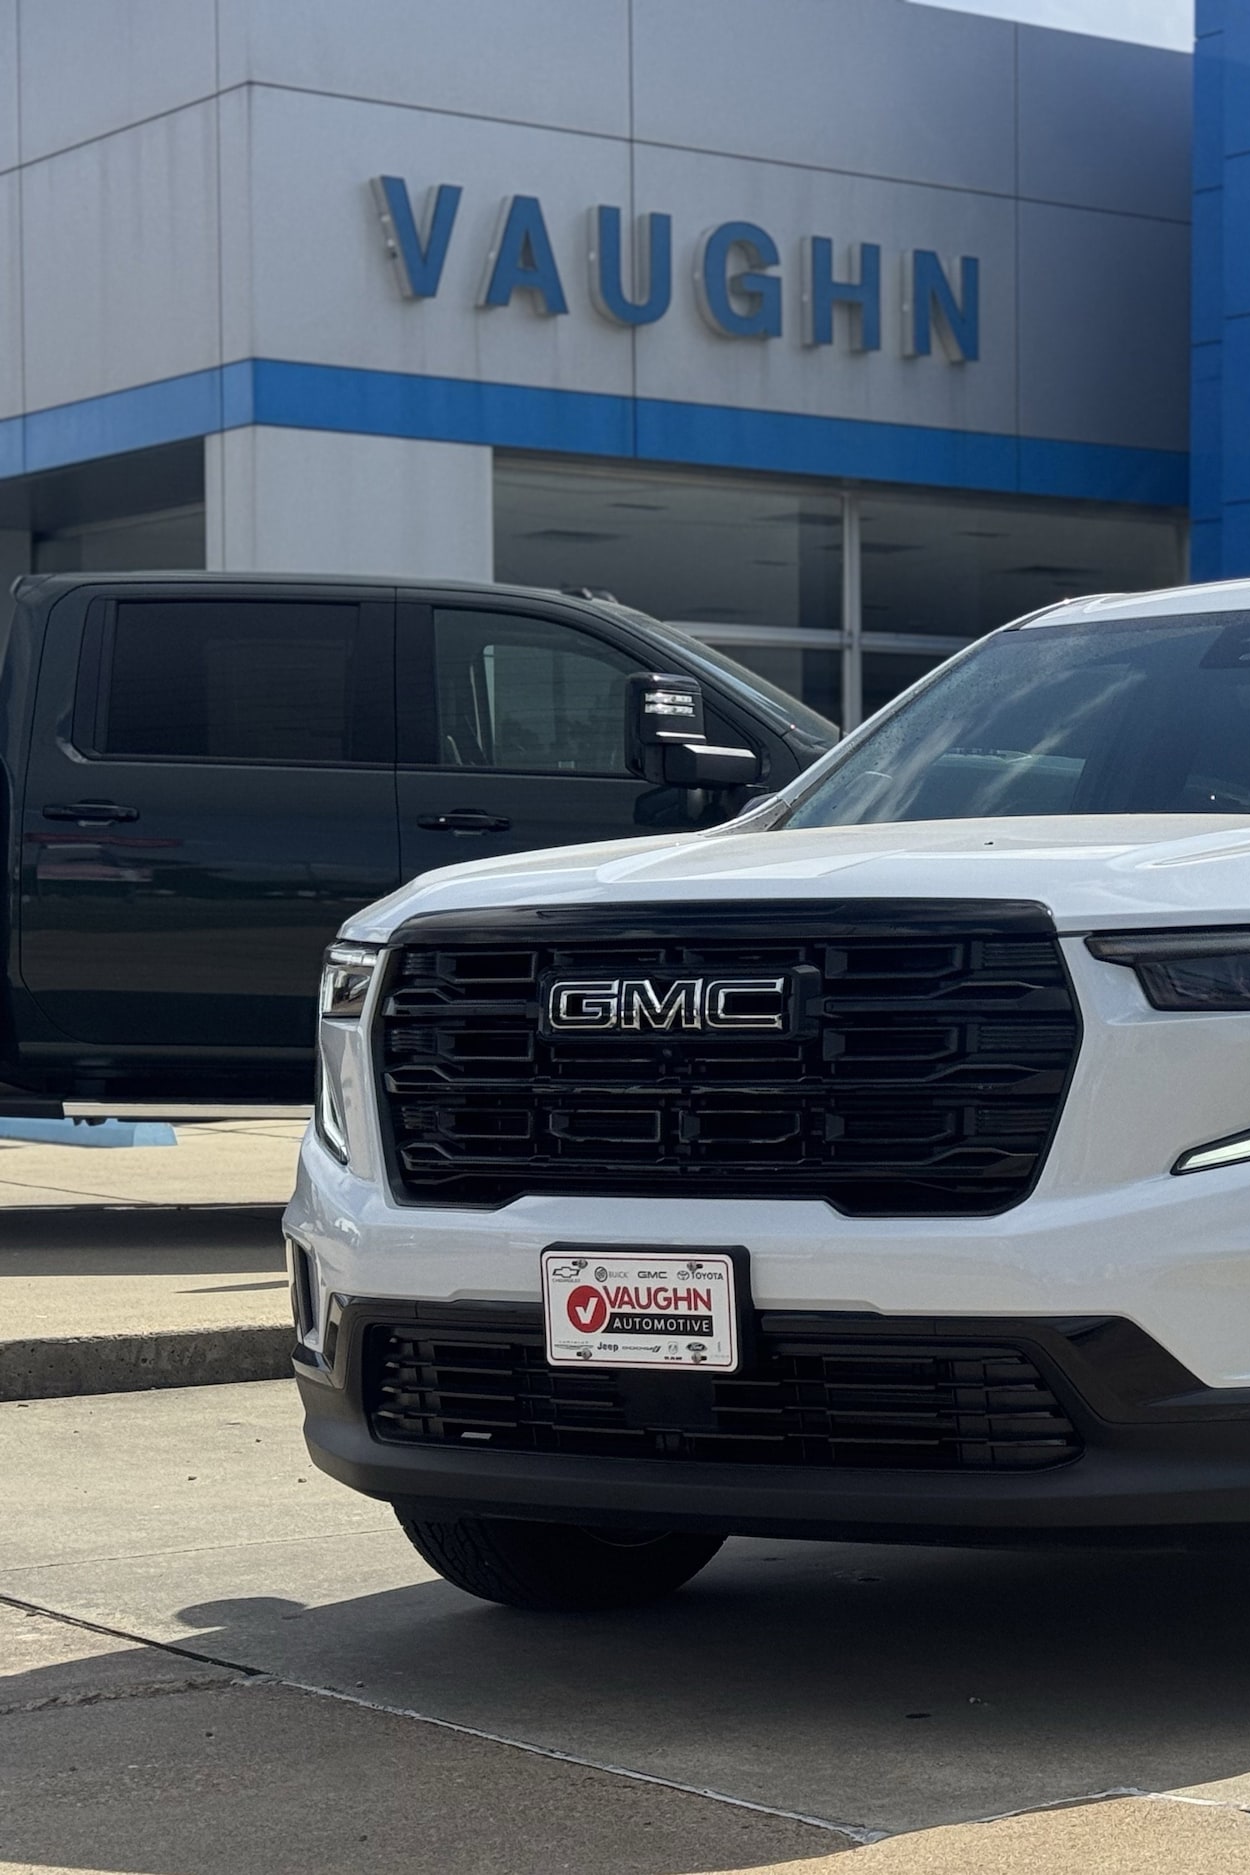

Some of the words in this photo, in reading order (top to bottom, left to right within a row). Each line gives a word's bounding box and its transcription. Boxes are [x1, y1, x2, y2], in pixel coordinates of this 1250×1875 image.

[371, 174, 980, 364] VAUGHN
[549, 977, 785, 1031] GMC
[609, 1271, 629, 1279] BUICK
[637, 1270, 668, 1279] GMC
[691, 1271, 724, 1280] TOYOTA
[602, 1285, 712, 1312] VAUGHN
[613, 1317, 711, 1332] AUTOMOTIVE
[597, 1341, 619, 1352] Jeep
